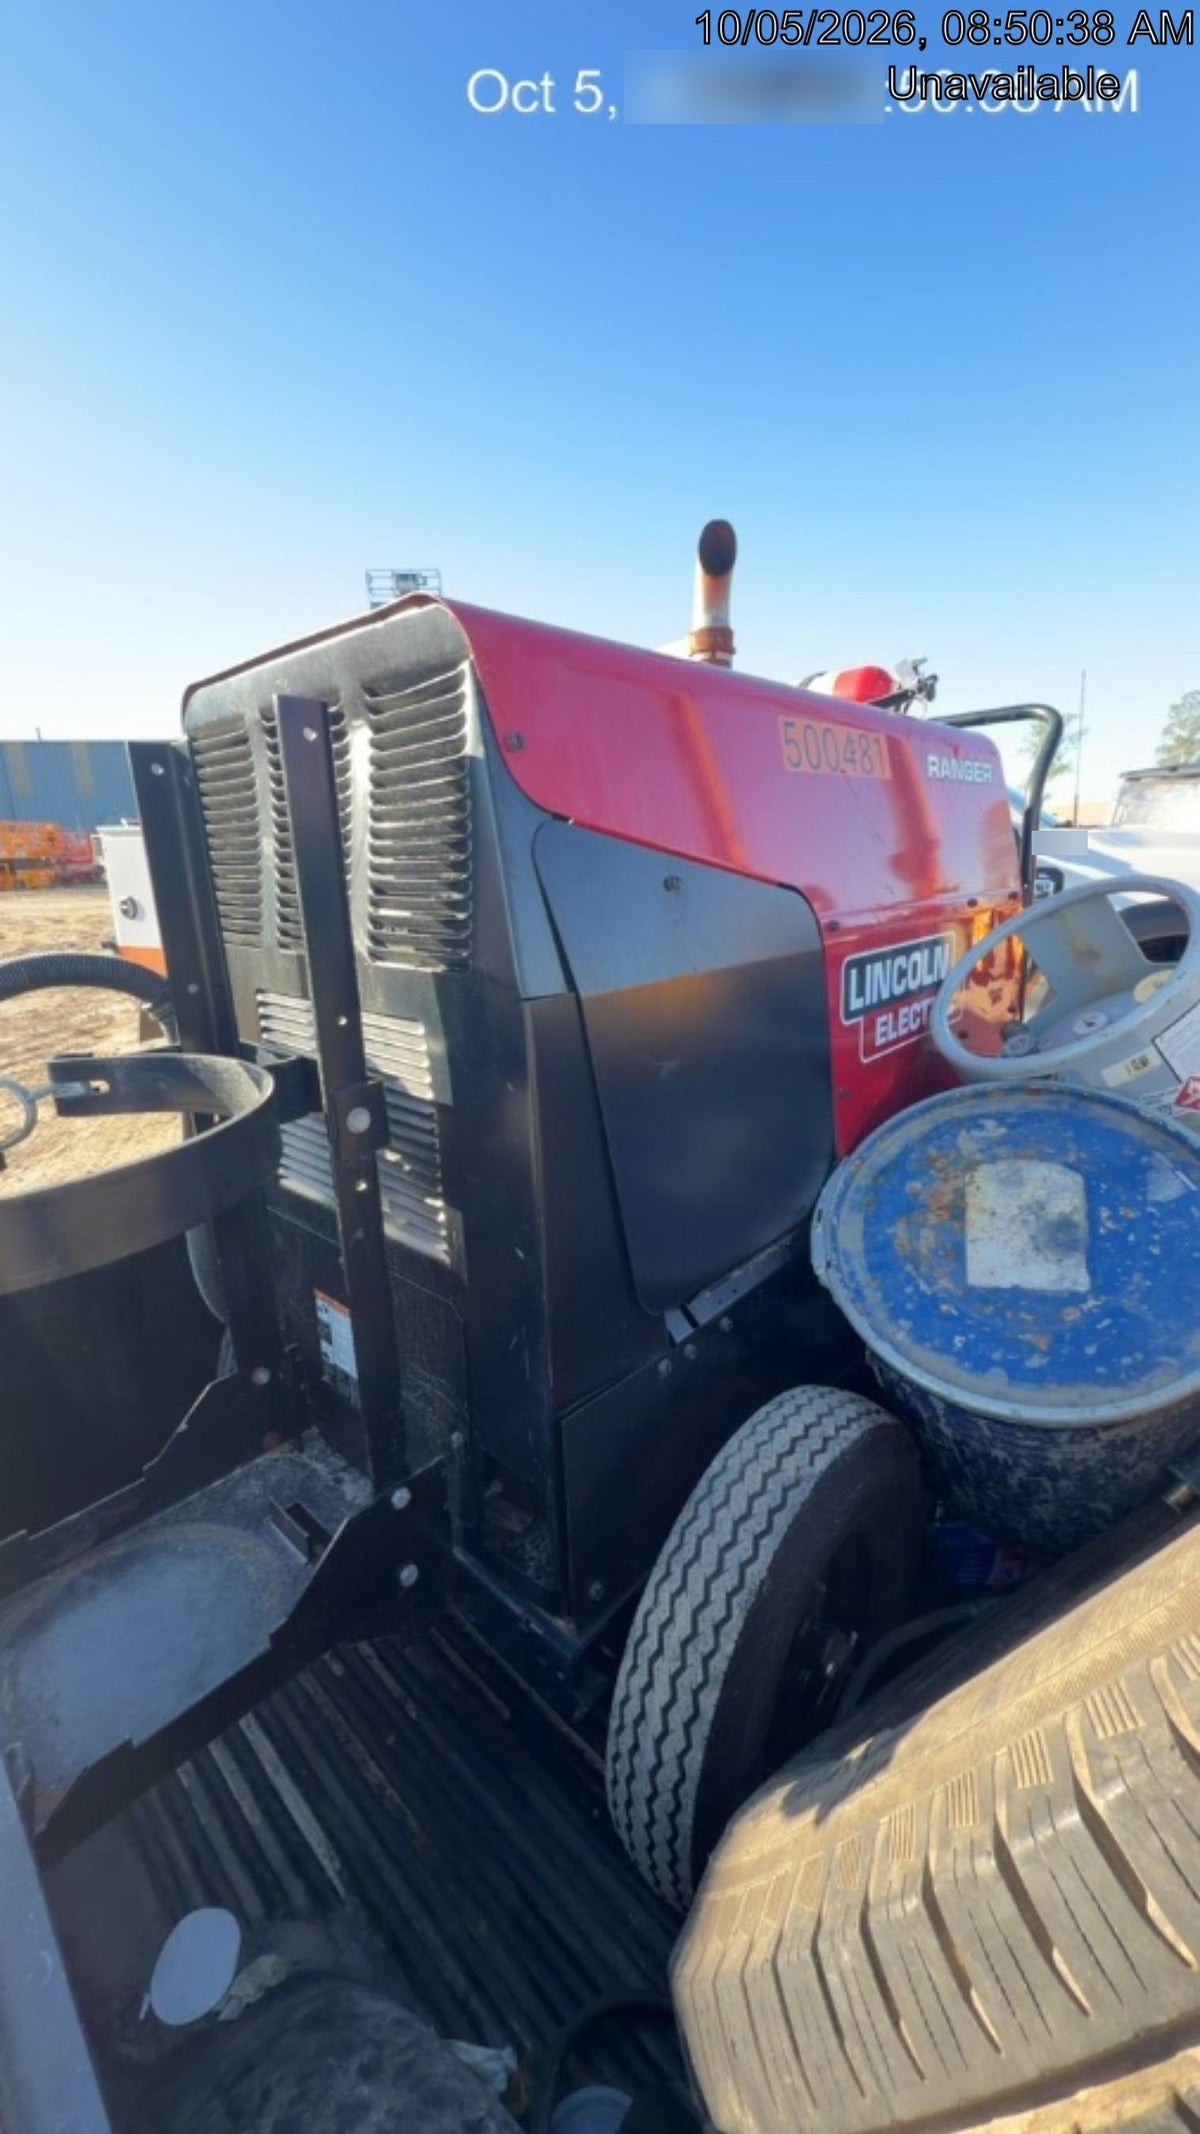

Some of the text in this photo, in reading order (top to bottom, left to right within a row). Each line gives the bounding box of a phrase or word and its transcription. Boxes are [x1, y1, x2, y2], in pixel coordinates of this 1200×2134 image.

[782, 720, 886, 776] 500481
[926, 755, 994, 784] RANGER
[848, 943, 950, 1012] LINCOLN
[874, 996, 935, 1047] ELECT
